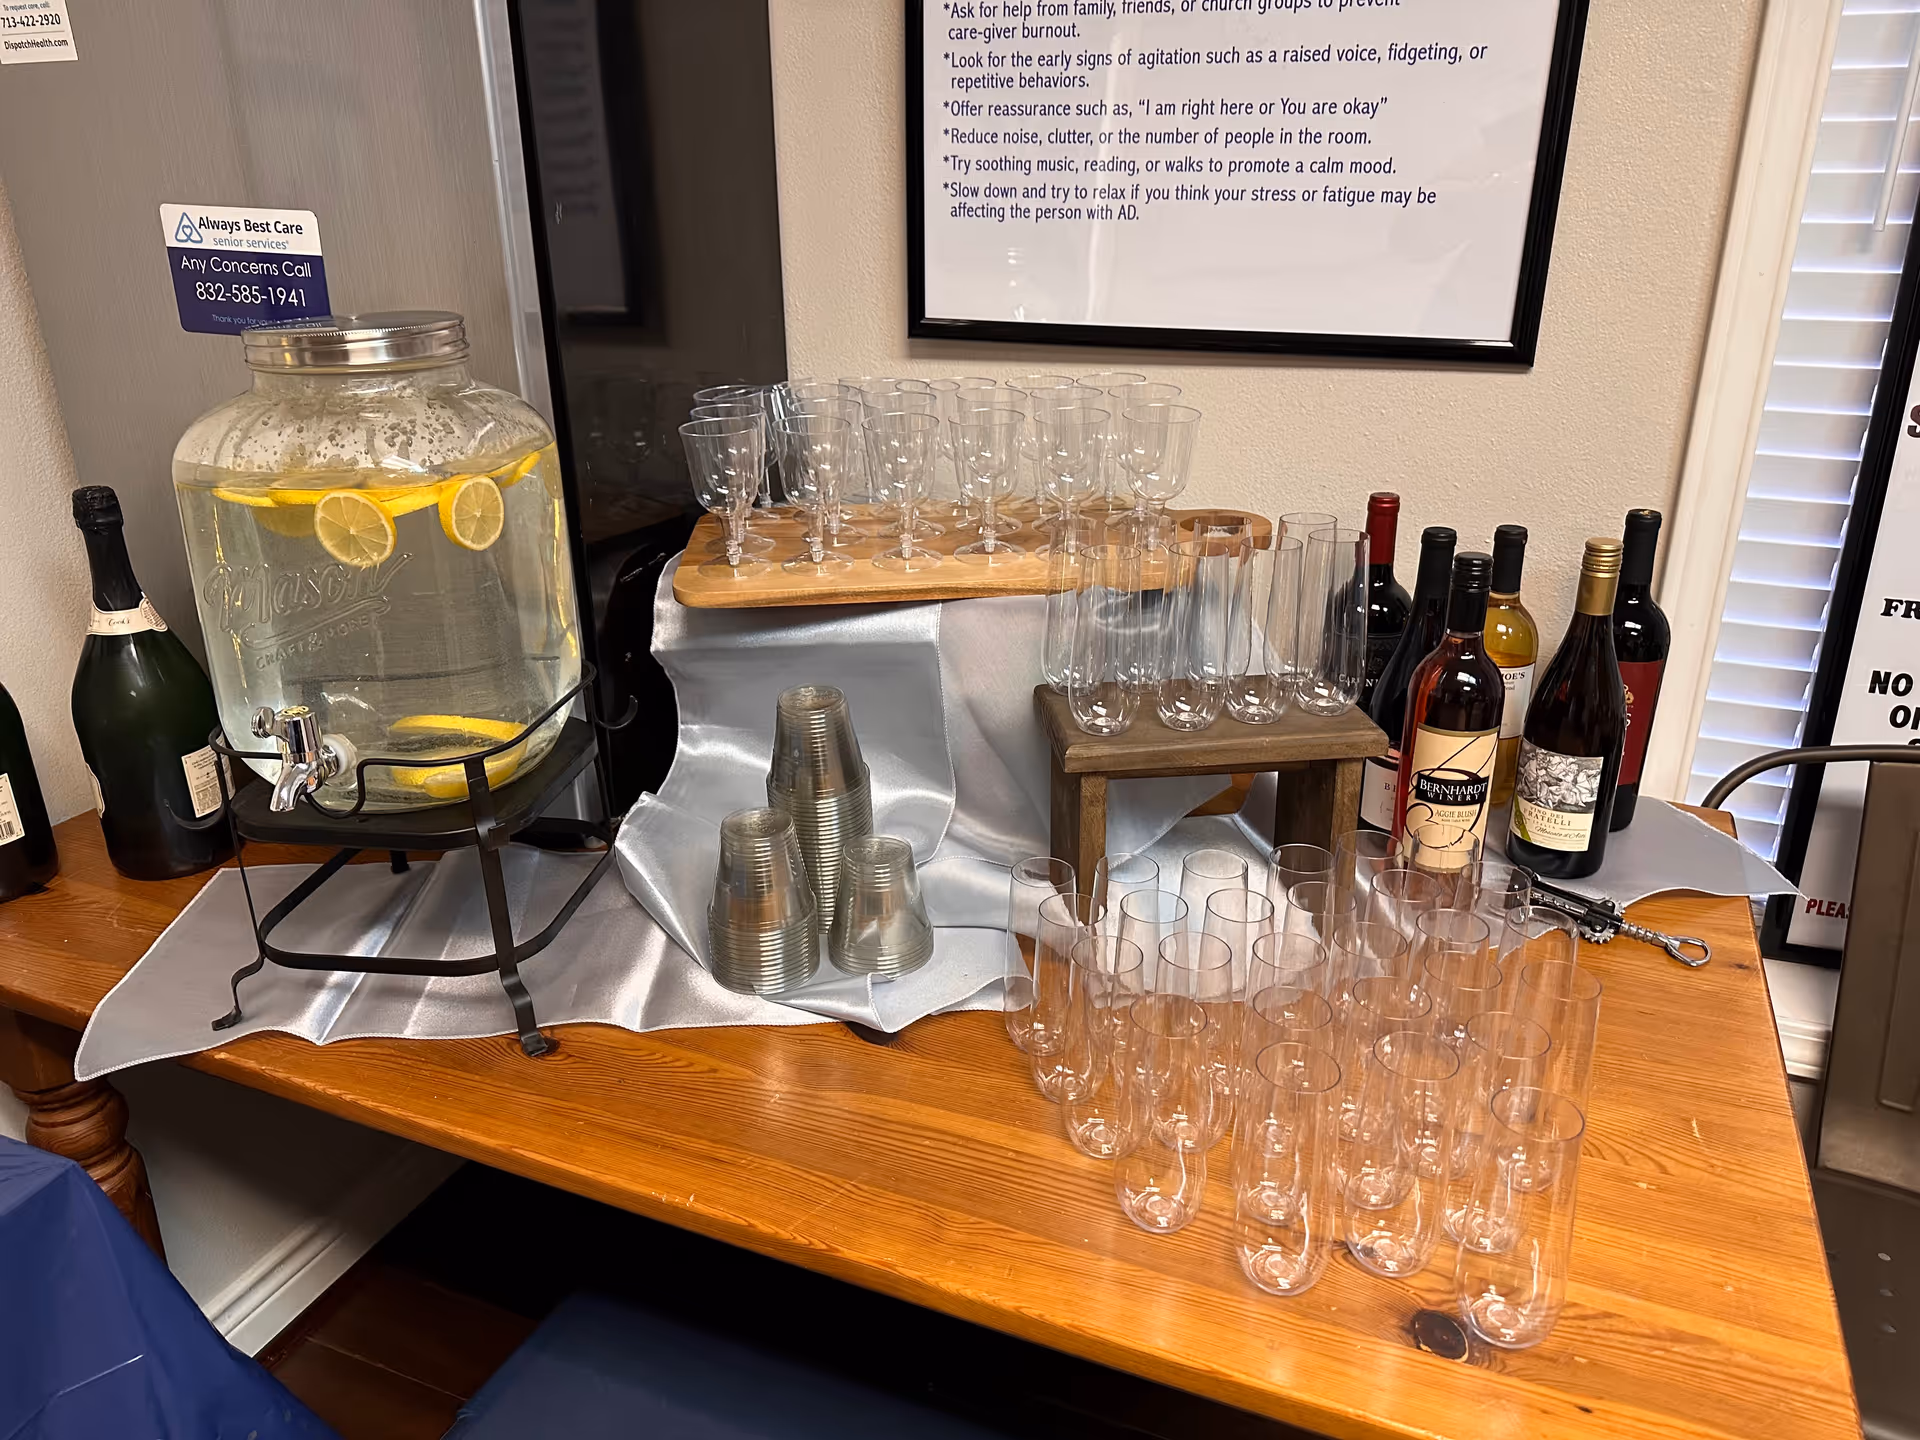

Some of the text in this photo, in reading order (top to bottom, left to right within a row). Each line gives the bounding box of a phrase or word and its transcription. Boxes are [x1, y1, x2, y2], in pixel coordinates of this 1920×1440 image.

[1, 13, 61, 28] 713-422-2920
[979, 1, 998, 18] for
[1003, 0, 1031, 21] help
[1037, 0, 1068, 16] from
[1074, 0, 1116, 19] family,
[1122, 0, 1174, 15] friends,
[1181, 0, 1196, 12] or
[1202, 0, 1252, 11] church
[1258, 0, 1311, 15] groups
[949, 22, 1080, 44] care-giver burnout.
[4, 38, 69, 51] DispatchHealth.com
[988, 51, 1006, 67] for
[1011, 51, 1032, 67] the
[1038, 50, 1072, 71] early
[1077, 50, 1112, 71] signs
[1118, 48, 1132, 65] of
[1138, 48, 1200, 70] agitation
[1206, 46, 1240, 64] such
[1246, 50, 1262, 63] as
[1269, 50, 1277, 63] a
[1283, 44, 1331, 62] raised
[1337, 44, 1381, 64] voice,
[1388, 42, 1462, 65] fidgeting,
[1470, 46, 1488, 59] or
[952, 72, 1089, 93] repetitive behaviors.
[988, 104, 1070, 116] reassurance
[1076, 99, 1107, 116] such
[1113, 104, 1132, 118] as,
[1155, 104, 1175, 115] am
[1182, 99, 1215, 120] right
[1220, 98, 1253, 115] here
[1259, 103, 1275, 115] or
[1281, 98, 1306, 114] You
[1312, 102, 1337, 114] are
[1004, 128, 1042, 146] noise,
[1048, 128, 1093, 146] clutter,
[1099, 132, 1113, 143] or
[1118, 128, 1140, 144] the
[1146, 127, 1199, 144] number
[1204, 127, 1219, 144] of
[1225, 127, 1274, 148] people
[1280, 128, 1292, 144] in
[1299, 127, 1322, 144] the
[1328, 132, 1371, 144] room.
[976, 155, 1031, 176] soothing
[1037, 156, 1078, 174] music,
[1085, 156, 1139, 176] reading,
[1146, 160, 1160, 172] or
[1165, 156, 1203, 172] walks
[1209, 158, 1222, 172] to
[1228, 158, 1289, 177] promote
[1295, 161, 1304, 173] a
[1310, 157, 1343, 173] calm
[1350, 157, 1396, 174] mood.
[984, 183, 1017, 199] down
[1022, 183, 1046, 198] and
[1051, 185, 1070, 203] try
[1075, 185, 1087, 199] to
[1093, 184, 1125, 199] relax
[1131, 184, 1139, 199] if
[1145, 188, 1169, 204] you
[1175, 184, 1209, 200] think
[1214, 189, 1246, 205] your
[1251, 187, 1296, 201] stress
[1302, 190, 1318, 201] or
[1323, 185, 1375, 207] fatigue
[1381, 191, 1412, 208] may
[1417, 187, 1436, 204] be
[951, 202, 1139, 223] affecting the person with AD.
[199, 216, 303, 234] Always Best Care
[213, 237, 244, 247] senior
[181, 255, 312, 278] Any Concerns Call
[195, 282, 306, 307] 832-585-1941
[212, 314, 232, 323] Thank
[1868, 670, 1914, 697] NO
[1420, 778, 1488, 796] BERNHARDT
[1427, 791, 1480, 802] WINERY
[1435, 809, 1477, 819] AGGIE BLUSH
[1523, 807, 1571, 827] FRATELLI
[1530, 806, 1547, 816] VINO
